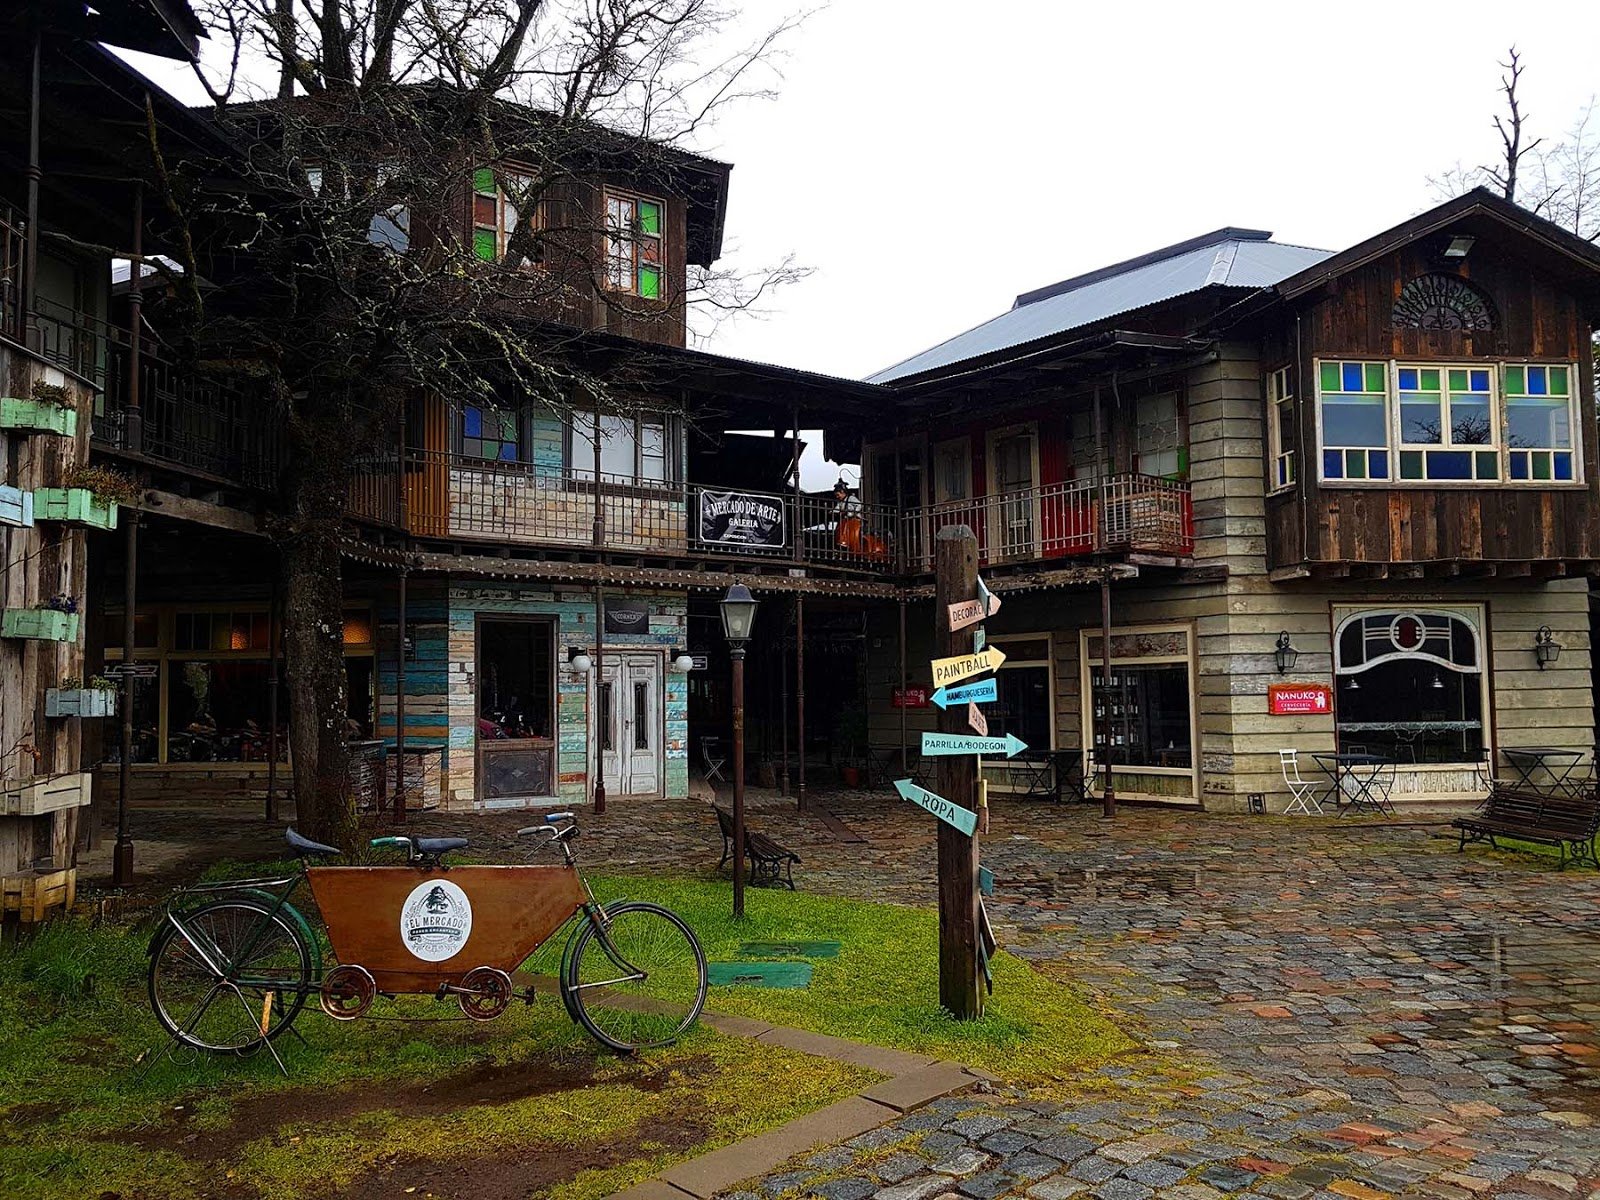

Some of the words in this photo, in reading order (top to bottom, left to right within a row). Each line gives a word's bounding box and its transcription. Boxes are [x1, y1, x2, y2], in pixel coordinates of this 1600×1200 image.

[711, 501, 744, 516] MERCADO
[745, 501, 756, 515] DE
[757, 504, 778, 522] ARTE
[729, 518, 758, 528] GALERIA
[936, 655, 991, 681] PAINTBALL
[1276, 692, 1315, 700] NANUKO
[924, 739, 1007, 751] PARRILLA/BODEGON
[921, 792, 955, 822] ROPA
[410, 919, 420, 928] EL
[423, 916, 463, 928] MERCADO
